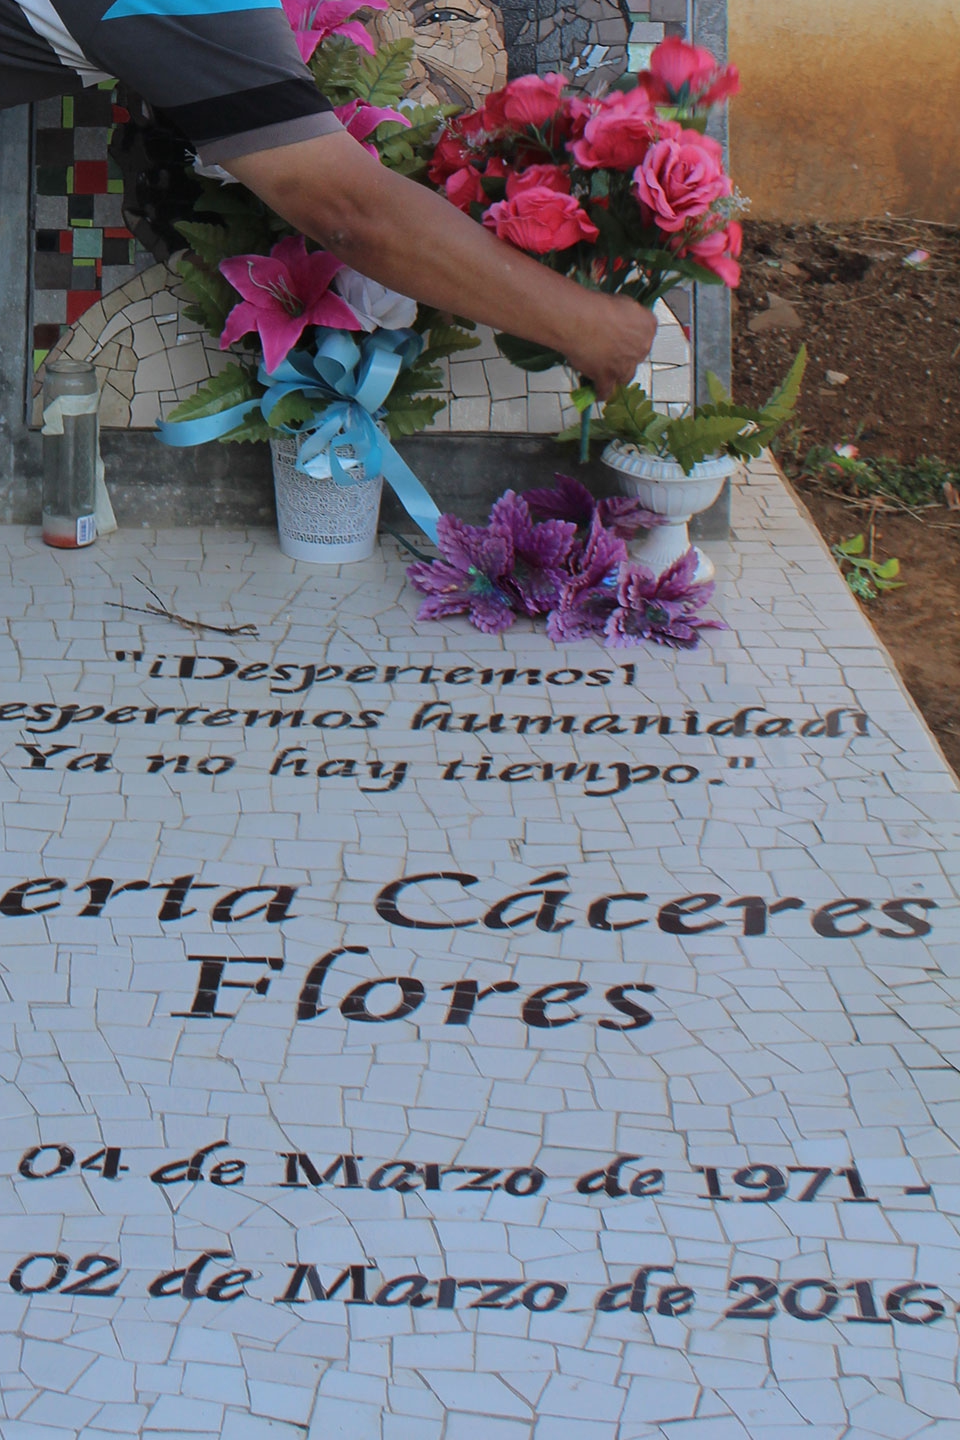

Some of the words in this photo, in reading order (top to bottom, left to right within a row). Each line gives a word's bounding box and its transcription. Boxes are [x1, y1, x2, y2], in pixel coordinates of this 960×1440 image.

[14, 743, 113, 772] Ya
[146, 754, 236, 776] no
[269, 747, 408, 793] hay
[375, 872, 939, 939] Cáceres
[170, 945, 656, 1031] Flores
[18, 1143, 130, 1180] 04
[151, 1140, 246, 1186] de
[277, 1152, 547, 1197] Marzo
[575, 1155, 666, 1198] de
[692, 1162, 880, 1203] 1971
[8, 1251, 122, 1297] 02
[148, 1250, 254, 1302] de
[273, 1262, 568, 1312] Marzo
[595, 1265, 696, 1317] de
[725, 1276, 946, 1325] 2016
